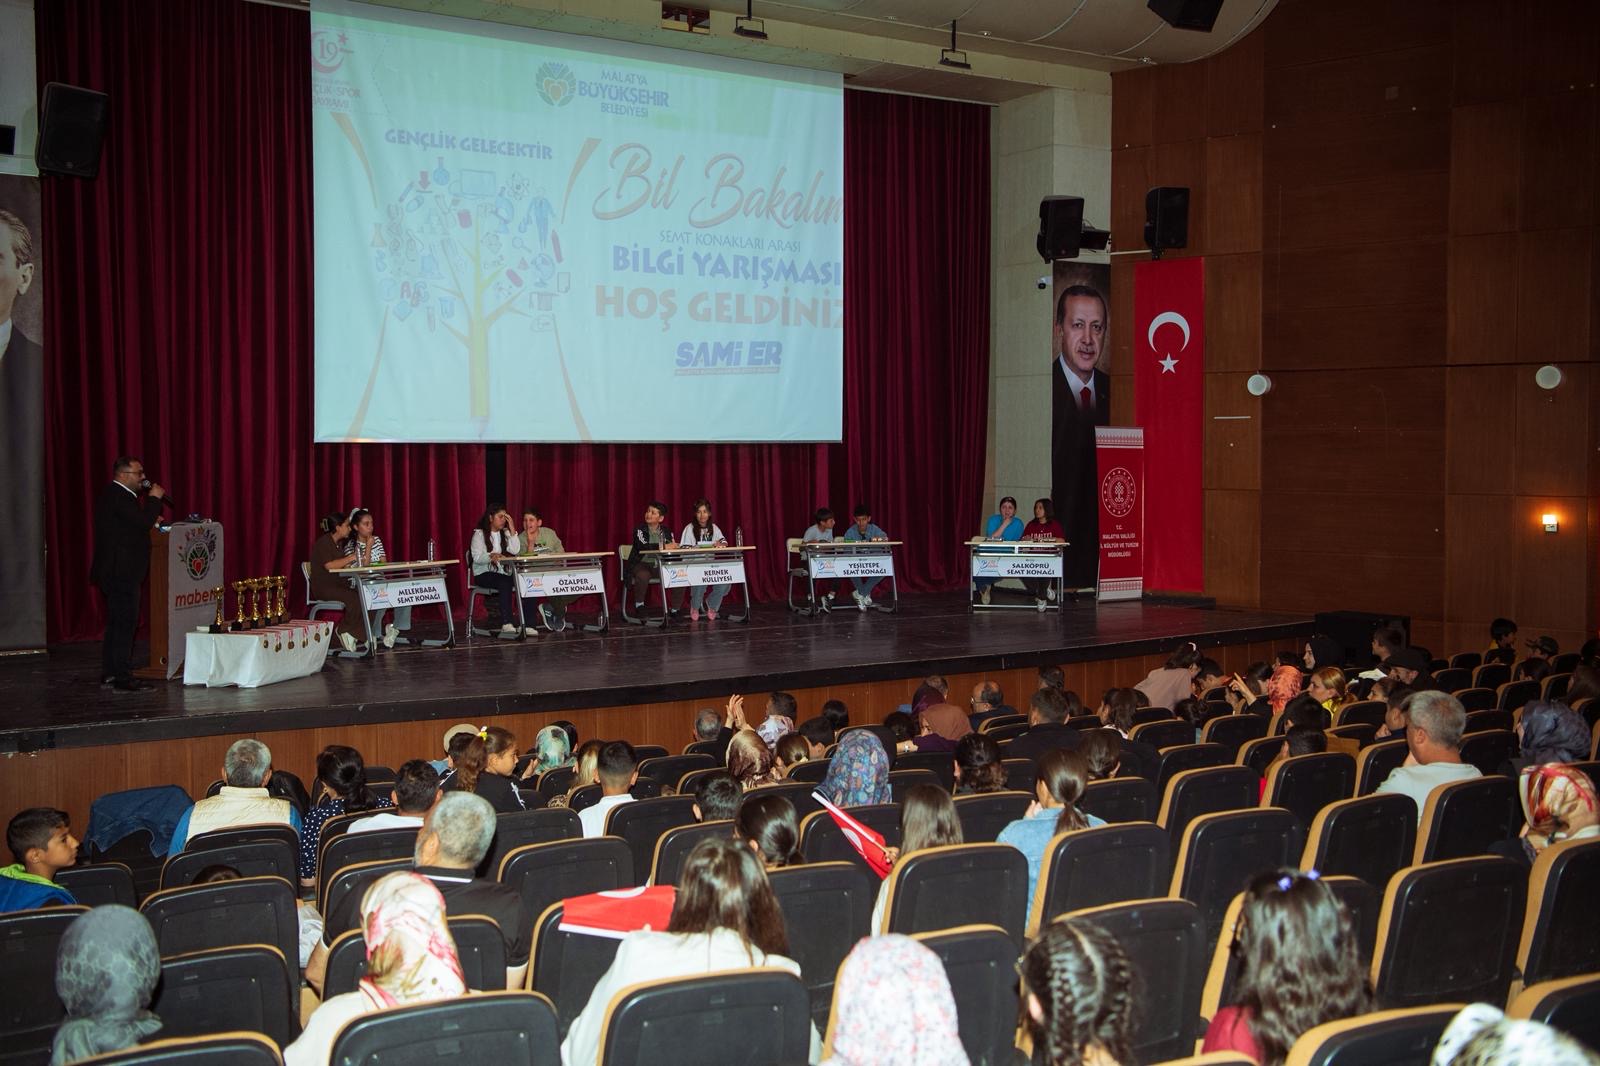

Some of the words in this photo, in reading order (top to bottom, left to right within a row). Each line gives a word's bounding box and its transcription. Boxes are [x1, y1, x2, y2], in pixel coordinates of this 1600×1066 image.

[601, 70, 649, 86] MALATYA
[578, 80, 670, 108] BÜYÜKŞEHİR
[385, 129, 457, 151] GENÇLİK
[460, 137, 553, 160] GELECEKTİR
[592, 142, 686, 221] Bil
[660, 230, 693, 244] SEMT
[696, 233, 765, 250] KONAKLARI
[768, 239, 801, 253] ARASI
[613, 243, 684, 275] BİLGİ
[692, 251, 842, 289] YARIŞMASI
[595, 285, 678, 332] HOŞ
[746, 341, 783, 366] ER
[397, 596, 414, 604] SEMT
[415, 592, 441, 602] KONAĞI
[398, 586, 437, 596] MELEKBABA
[570, 584, 597, 592] KONAĞI
